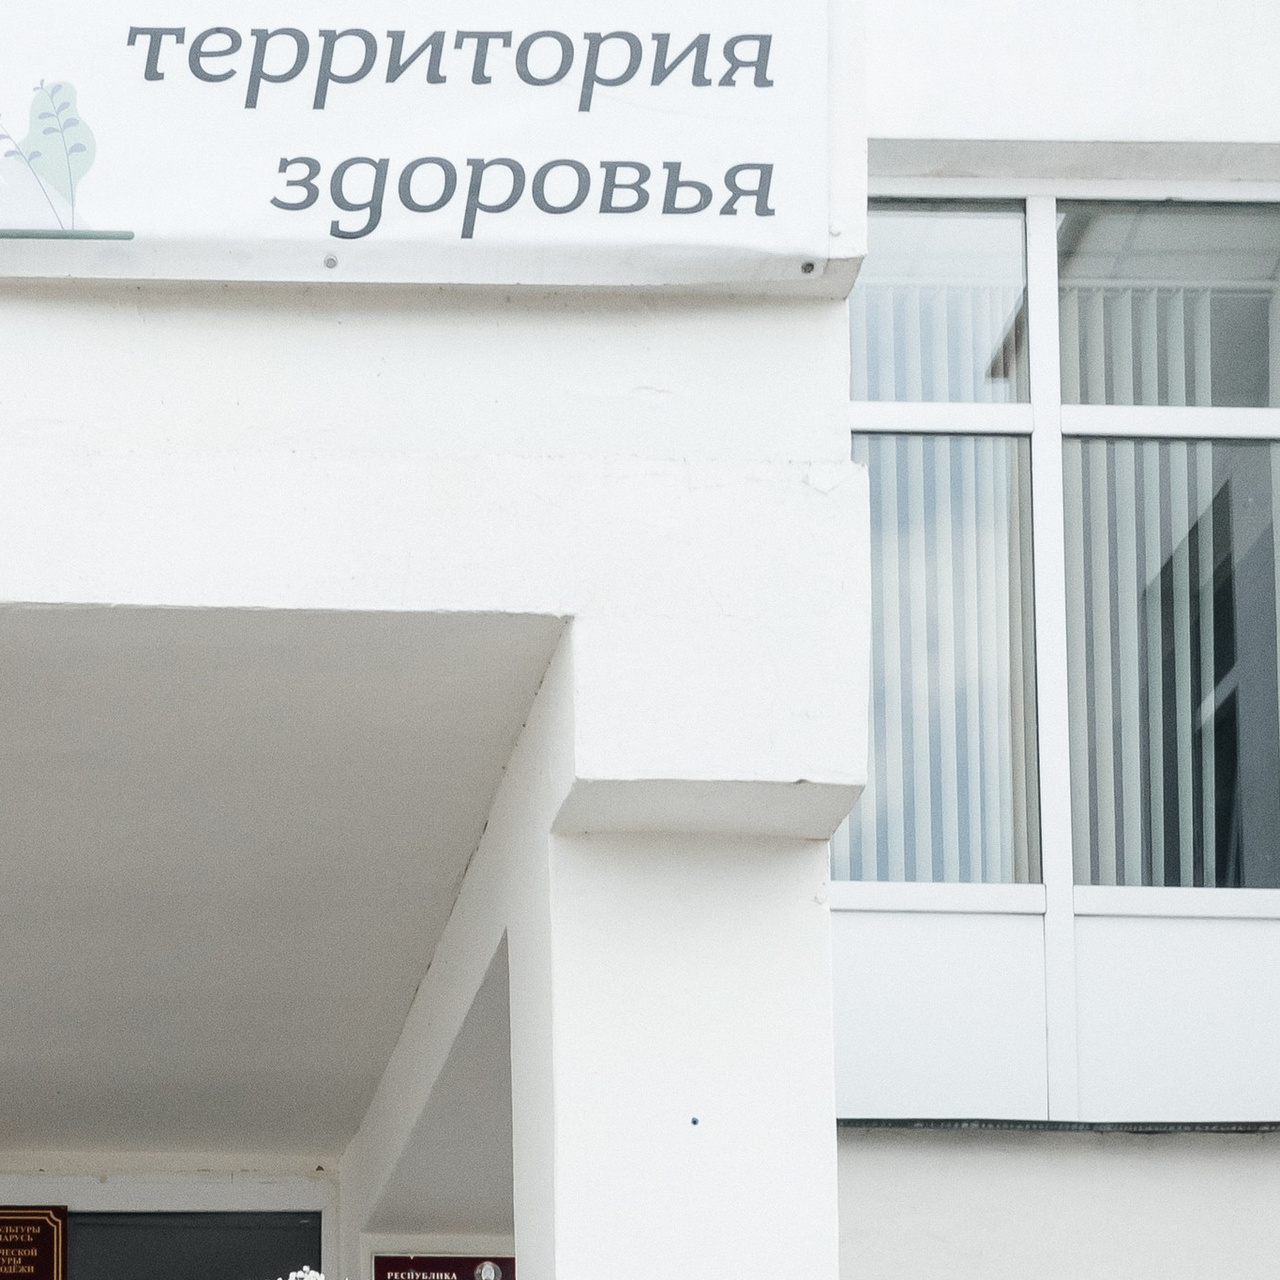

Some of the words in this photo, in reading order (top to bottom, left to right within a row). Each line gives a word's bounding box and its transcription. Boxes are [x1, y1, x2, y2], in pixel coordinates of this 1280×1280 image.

[127, 26, 774, 112] территория
[270, 156, 775, 240] здоровья
[387, 1272, 457, 1280] РЕСПУБЛИКА
